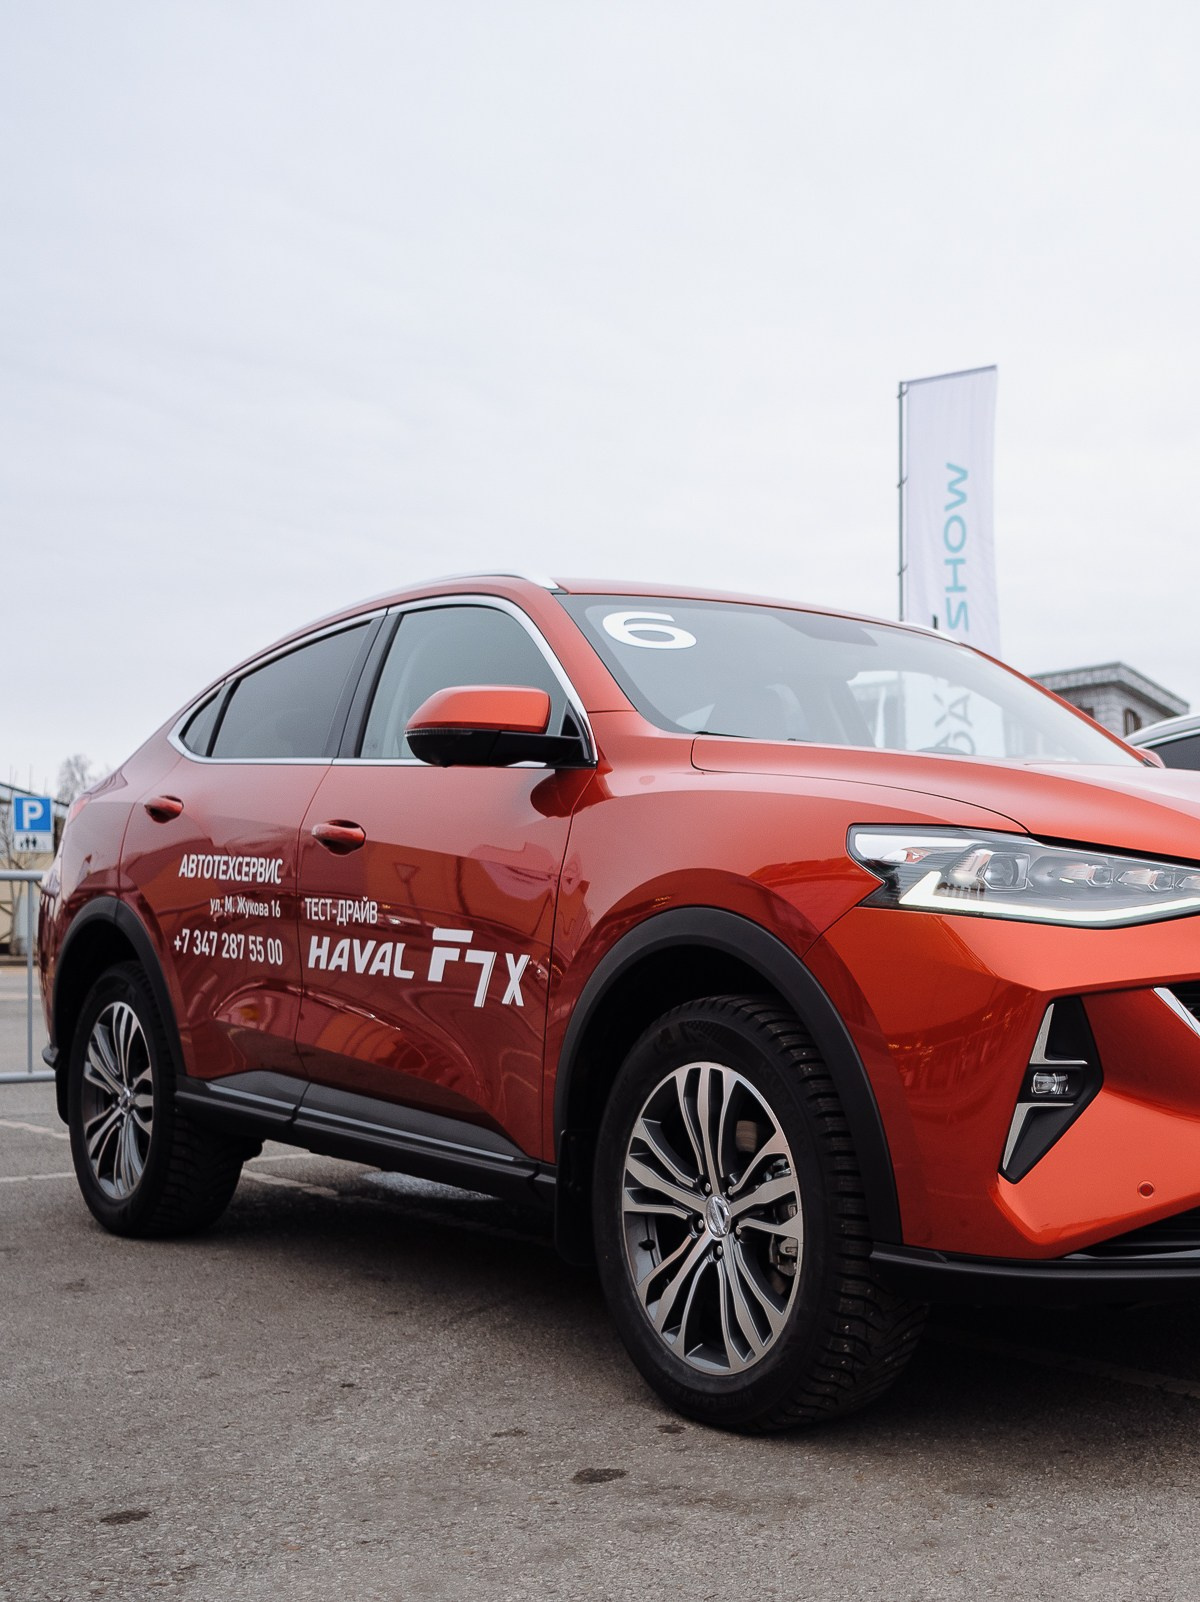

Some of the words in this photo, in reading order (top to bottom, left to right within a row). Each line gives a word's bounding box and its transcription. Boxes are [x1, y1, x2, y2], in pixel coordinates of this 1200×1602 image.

[944, 462, 969, 632] SHOW
[602, 611, 697, 650] 6
[23, 801, 44, 829] P
[178, 854, 283, 884] АВТОТЕХСЕРВИС
[210, 898, 222, 915] ул.
[225, 896, 235, 914] М.
[236, 897, 269, 918] Жукова
[271, 900, 281, 918] 16
[305, 896, 378, 926] ТЕСТ-ДРАЙВ
[174, 928, 190, 954] +7
[193, 930, 217, 957] 347
[221, 932, 245, 960] 287
[249, 934, 265, 963] 55
[267, 938, 283, 966] 00
[308, 935, 415, 980] HAVAL
